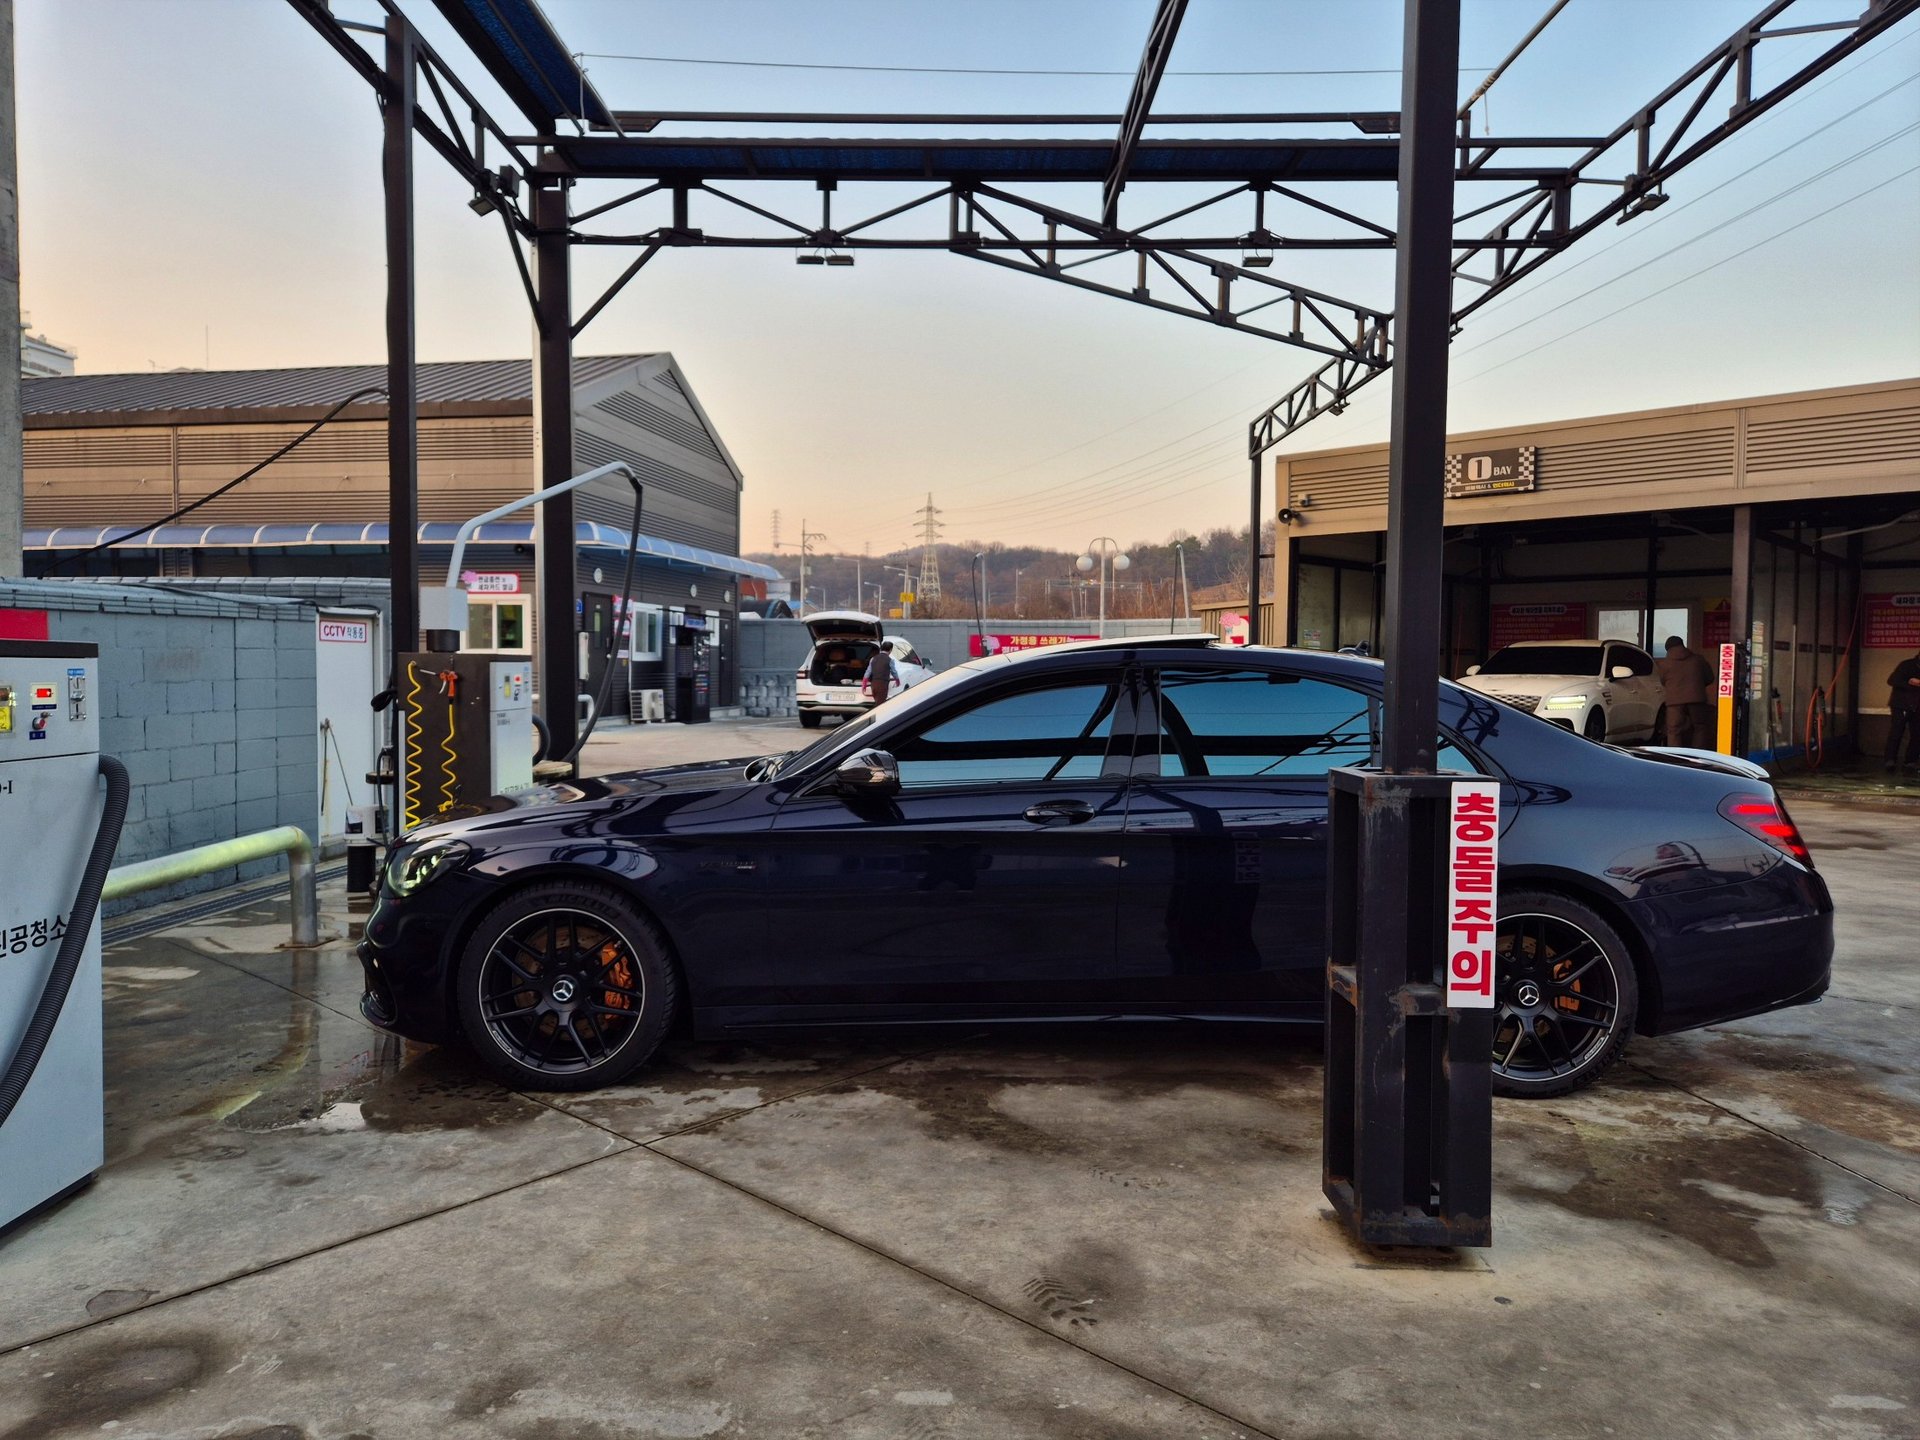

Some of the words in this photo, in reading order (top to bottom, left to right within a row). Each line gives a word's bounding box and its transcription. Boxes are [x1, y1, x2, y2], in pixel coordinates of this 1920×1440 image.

[1493, 465, 1512, 476] BAY
[323, 624, 346, 637] CCTV
[1010, 635, 1037, 646] 가정용
[1720, 645, 1734, 697] 충돌주의
[1450, 792, 1497, 997] 충돌주의
